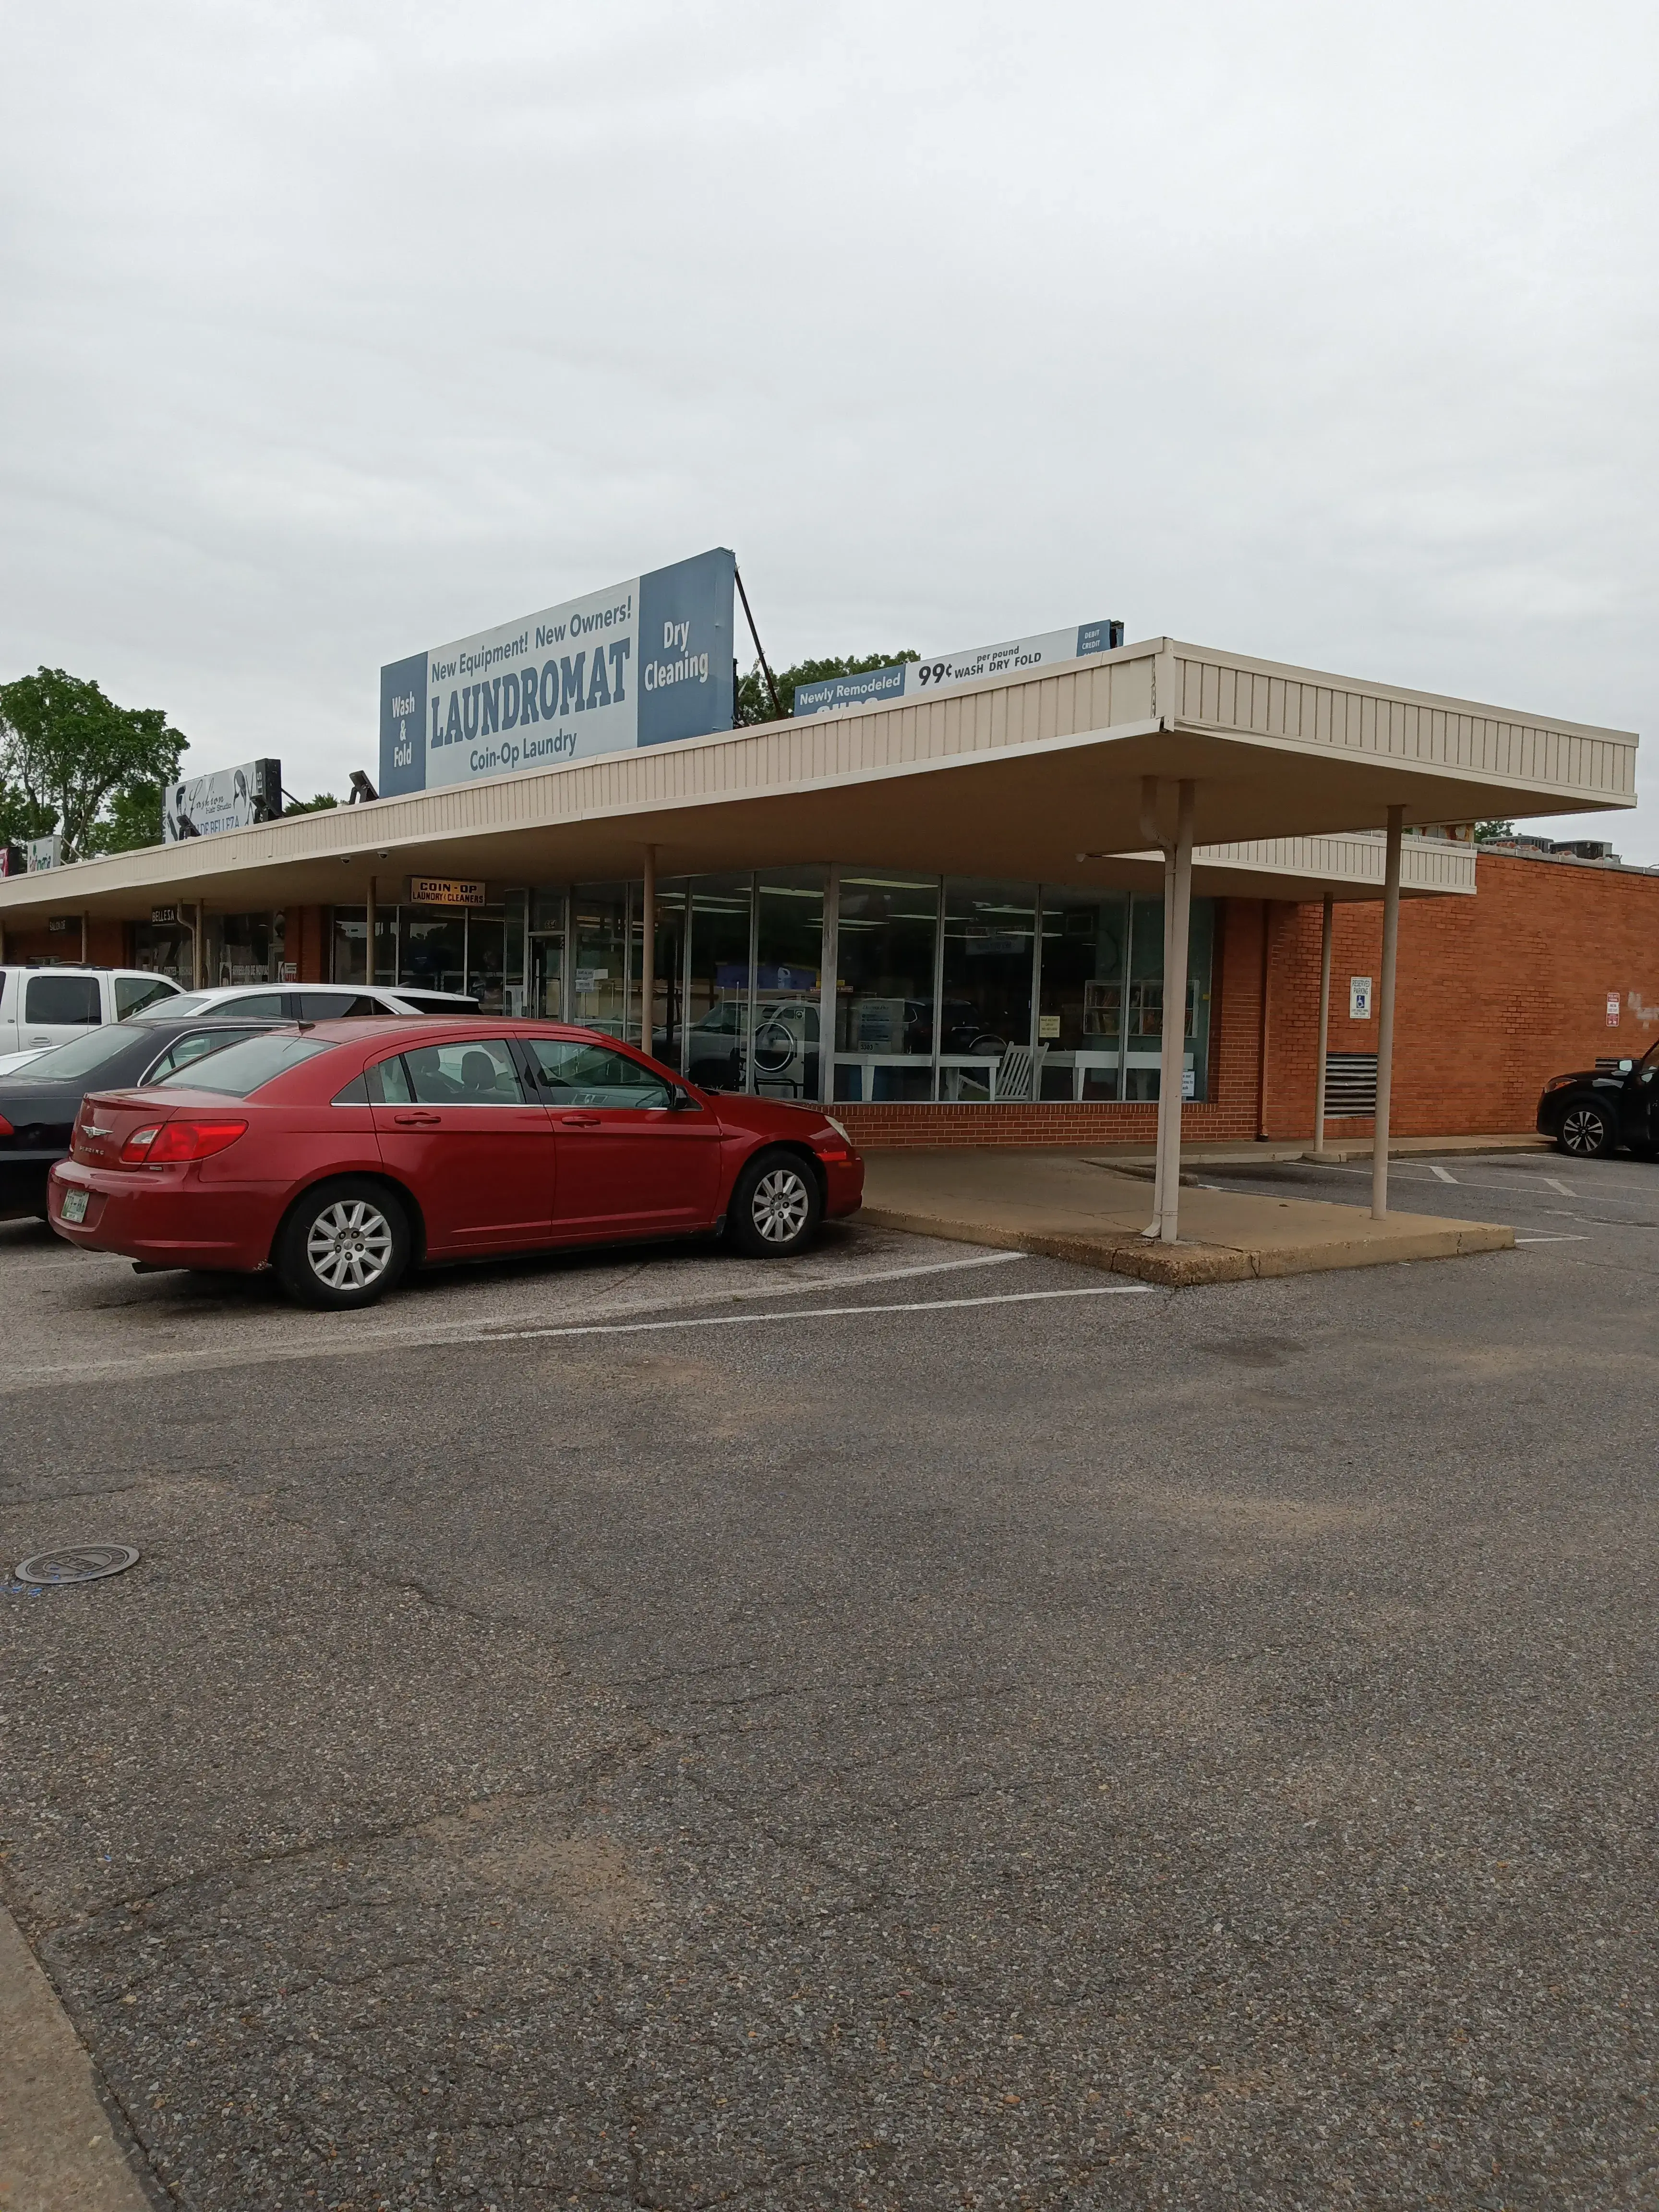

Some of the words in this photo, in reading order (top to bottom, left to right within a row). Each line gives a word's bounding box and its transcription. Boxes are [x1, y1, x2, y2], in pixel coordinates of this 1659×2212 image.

[432, 661, 456, 683] New
[459, 632, 528, 674] Equipment!
[535, 625, 565, 649] New
[570, 595, 632, 637] Owners!
[664, 620, 690, 651] Dry
[1082, 640, 1100, 649] CREDIT
[1084, 629, 1100, 639] DEBIT
[918, 663, 952, 686] 99¢
[954, 664, 983, 679] WASH
[989, 659, 1010, 672] DRY
[1015, 652, 1042, 667] FOLD
[977, 653, 991, 664] per
[992, 646, 1019, 661] pound
[644, 652, 708, 692] Cleaning
[431, 637, 630, 749] LAUNDROMAT
[800, 688, 834, 705] Newly
[837, 673, 901, 697] Remodeled
[392, 692, 415, 718] Wash
[399, 720, 407, 741] &
[394, 743, 412, 768] Fold
[470, 743, 519, 772] Coin-Op
[523, 728, 577, 760] Laundry
[413, 892, 443, 901] LAUNDRY
[447, 893, 483, 903] CLEANERS
